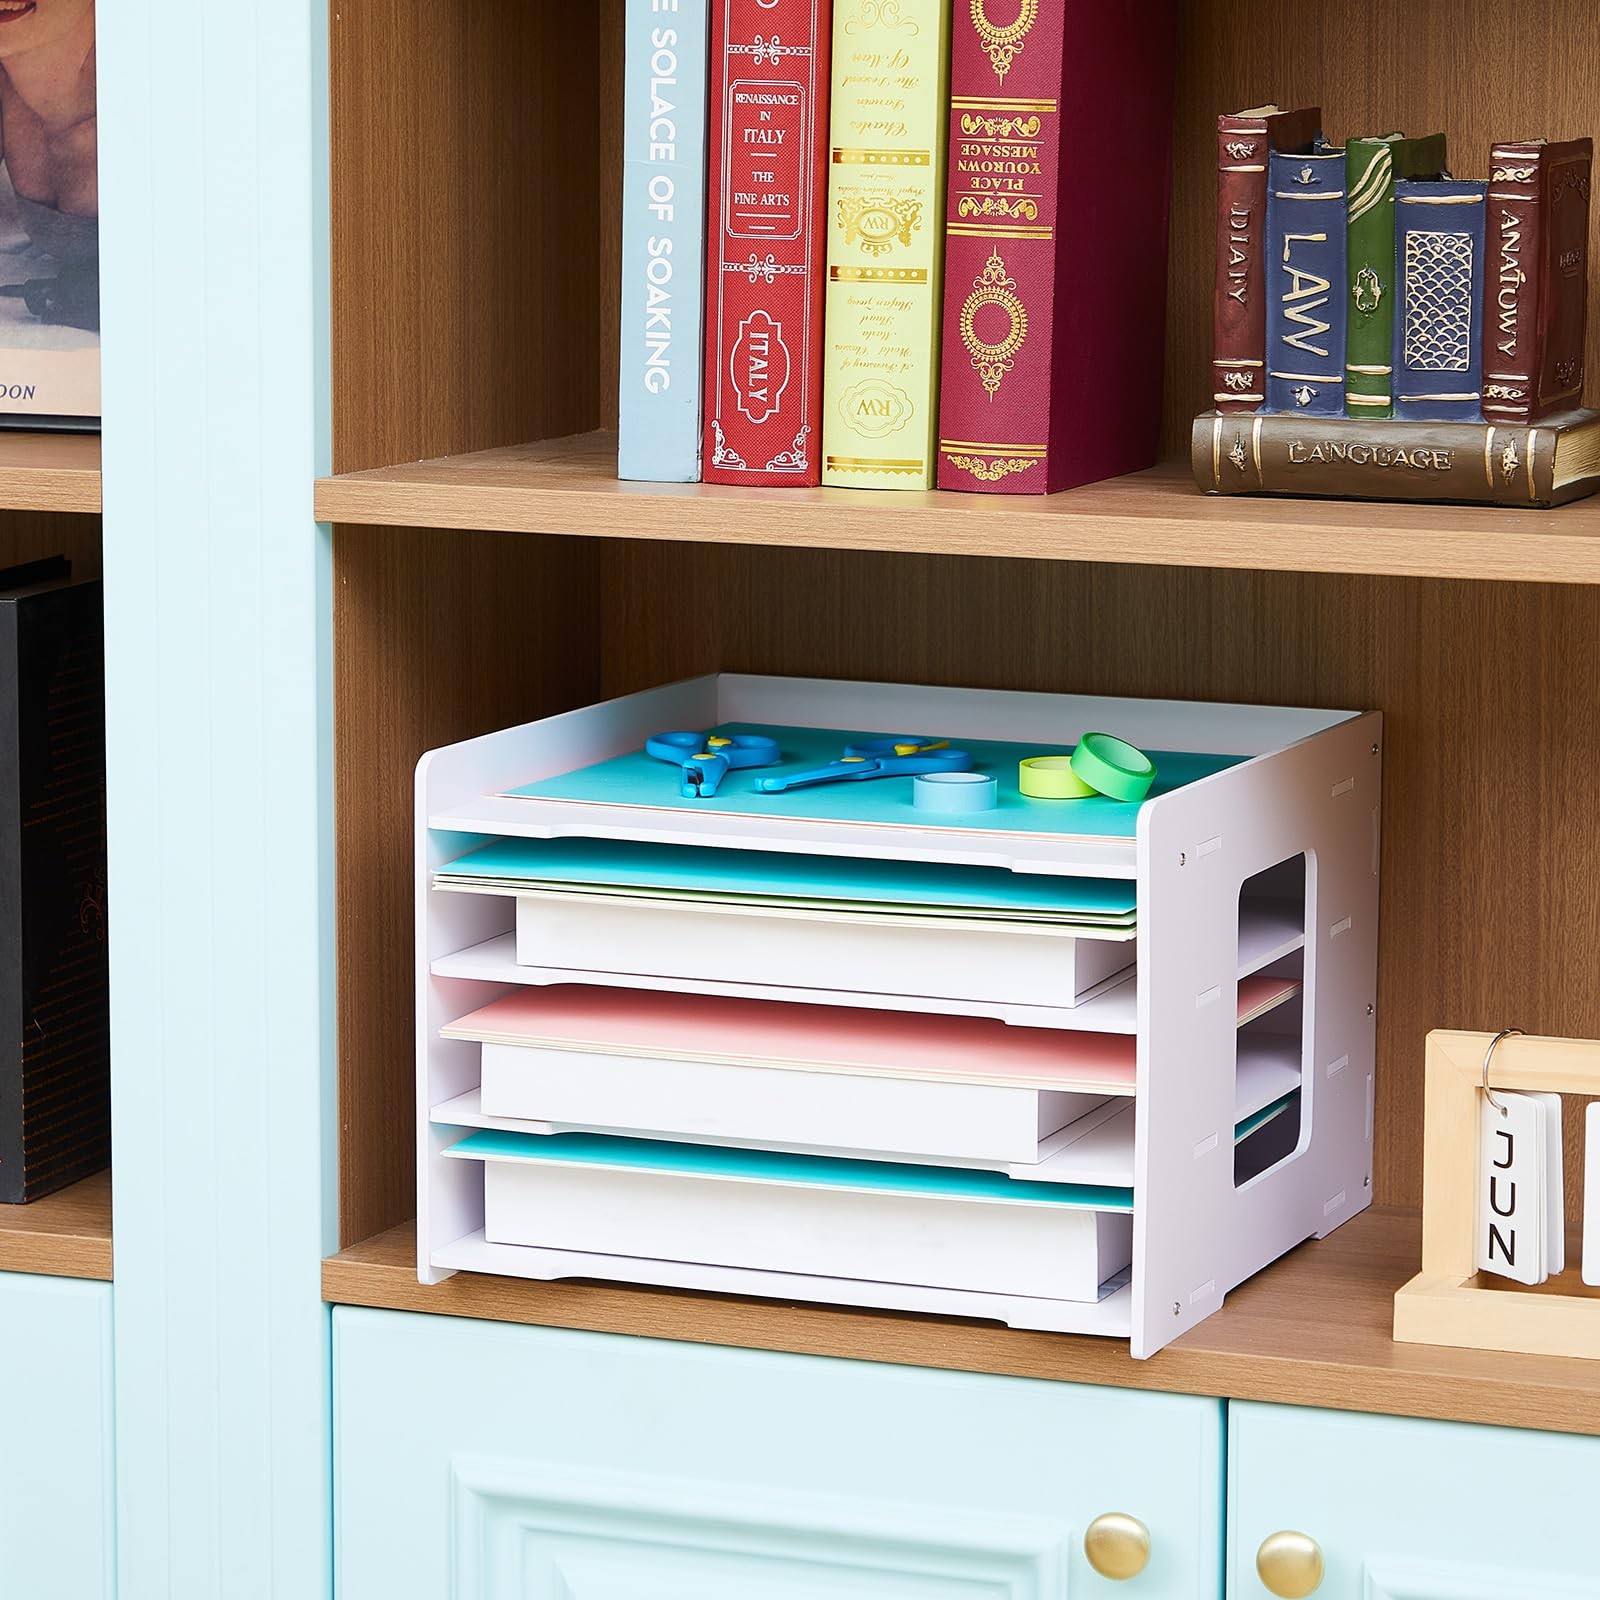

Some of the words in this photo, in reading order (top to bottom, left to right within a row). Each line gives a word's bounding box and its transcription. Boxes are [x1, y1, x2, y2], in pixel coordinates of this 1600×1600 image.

[887, 48, 911, 69] Of
[895, 77, 920, 89] The
[649, 27, 678, 162] SOLACE
[734, 93, 800, 106] RENAISSANCE
[855, 98, 905, 111] Darwin
[759, 111, 772, 121] IN
[743, 128, 786, 144] ITALY
[848, 120, 908, 137] Charles
[960, 144, 1038, 158] MESSAGE
[957, 160, 1042, 174] YOUROWN
[751, 171, 775, 183] THE
[970, 177, 1024, 190] PLACE
[647, 175, 676, 222] OF
[734, 192, 757, 206] FINE
[761, 193, 790, 206] ARTS
[863, 216, 889, 230] RW
[1281, 232, 1331, 357] LAW
[643, 235, 674, 395] SOAKING
[879, 346, 912, 357] World
[747, 331, 769, 403] ITALY
[853, 358, 898, 373] Treasury
[856, 399, 891, 417] RW
[1286, 440, 1456, 470] LANGUAGE
[1488, 1129, 1517, 1267] JUN
